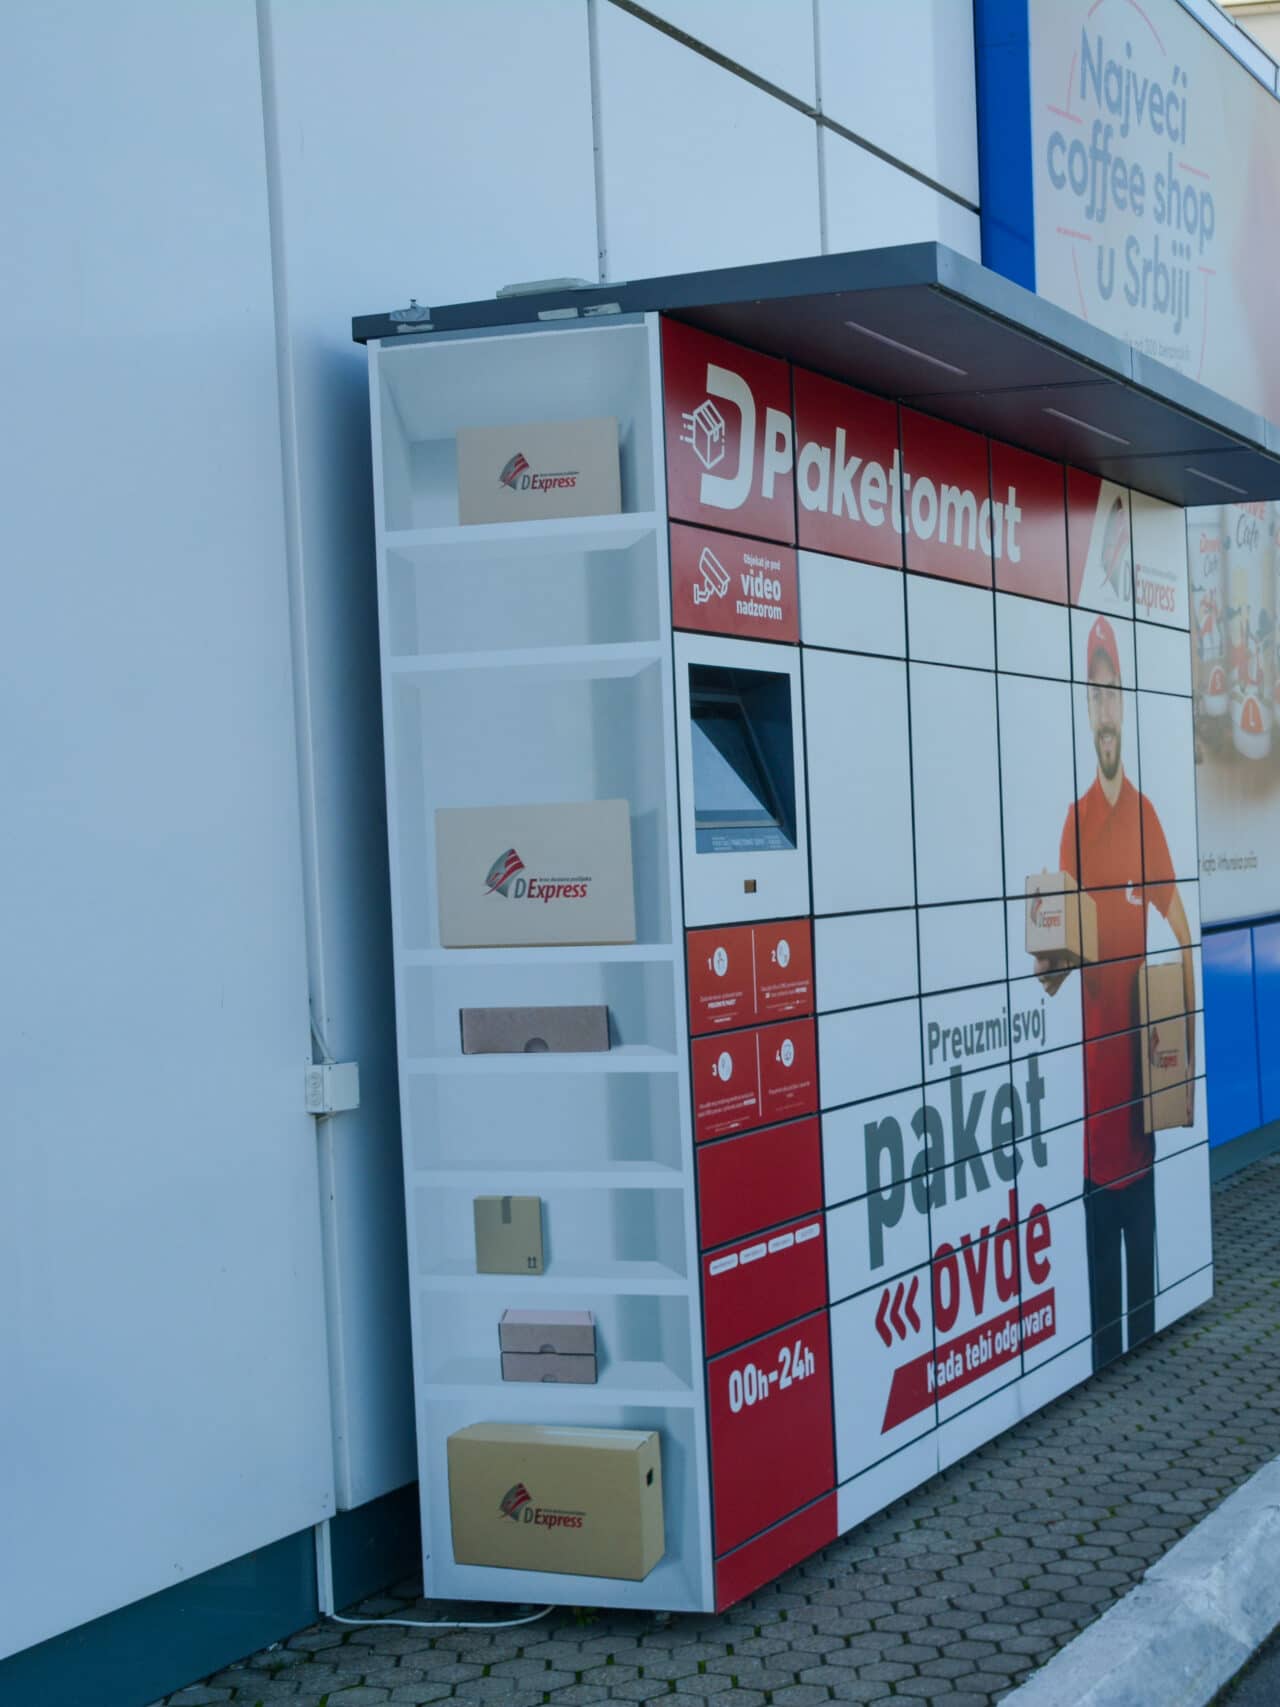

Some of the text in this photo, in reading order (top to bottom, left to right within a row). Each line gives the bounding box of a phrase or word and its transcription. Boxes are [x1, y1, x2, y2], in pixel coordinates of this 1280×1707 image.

[1080, 25, 1188, 145] Najveći
[1047, 119, 1215, 255] coffee shop
[1096, 236, 1191, 336] u Srbiji
[762, 408, 1022, 563] Paketomat
[736, 599, 783, 620] nadzorom
[741, 568, 782, 602] video
[927, 998, 1047, 1066] Preuzmi svoj
[864, 1052, 1048, 1271] paket
[932, 1188, 1052, 1333] ovde
[728, 1340, 815, 1414] 00h-24h
[926, 1305, 1053, 1393] Kada tebi odgovara
